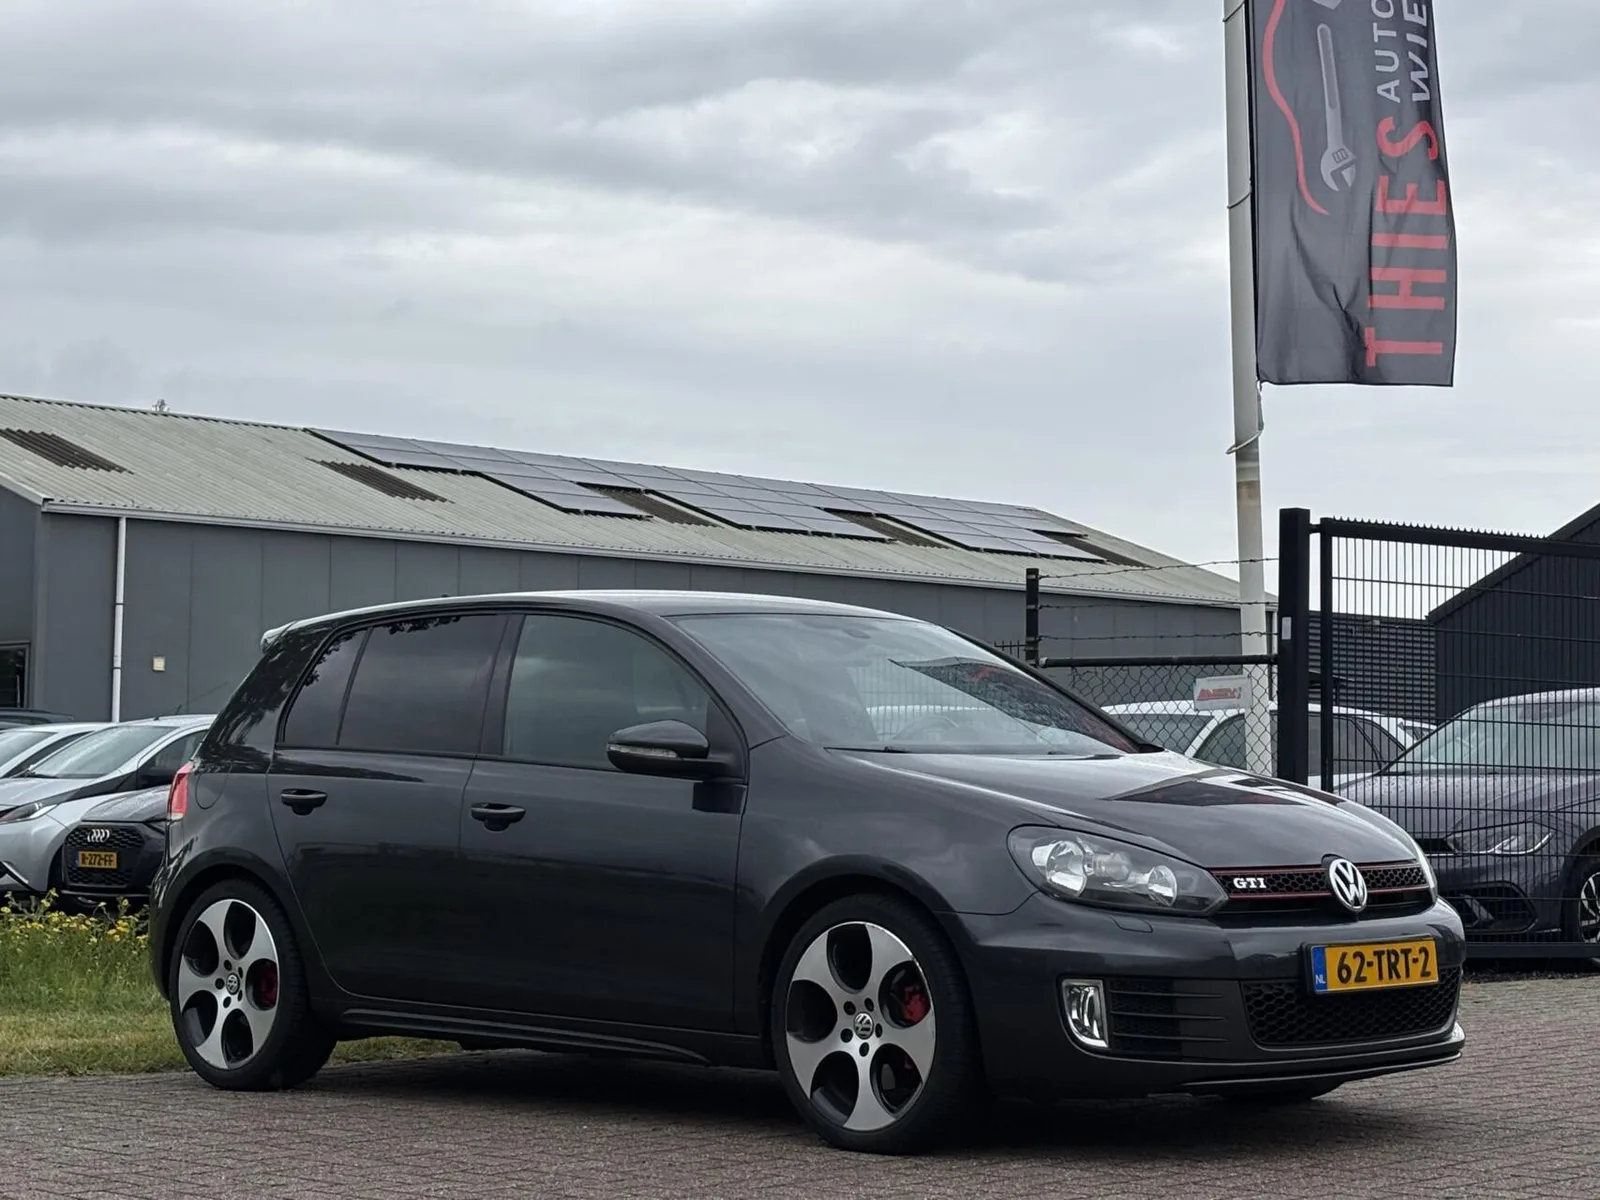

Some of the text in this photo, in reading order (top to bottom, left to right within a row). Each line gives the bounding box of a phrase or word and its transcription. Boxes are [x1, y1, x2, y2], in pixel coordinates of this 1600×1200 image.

[1365, 117, 1449, 366] THIES
[1233, 877, 1267, 889] GTI
[1315, 946, 1431, 985] NL 62-TRT-2
